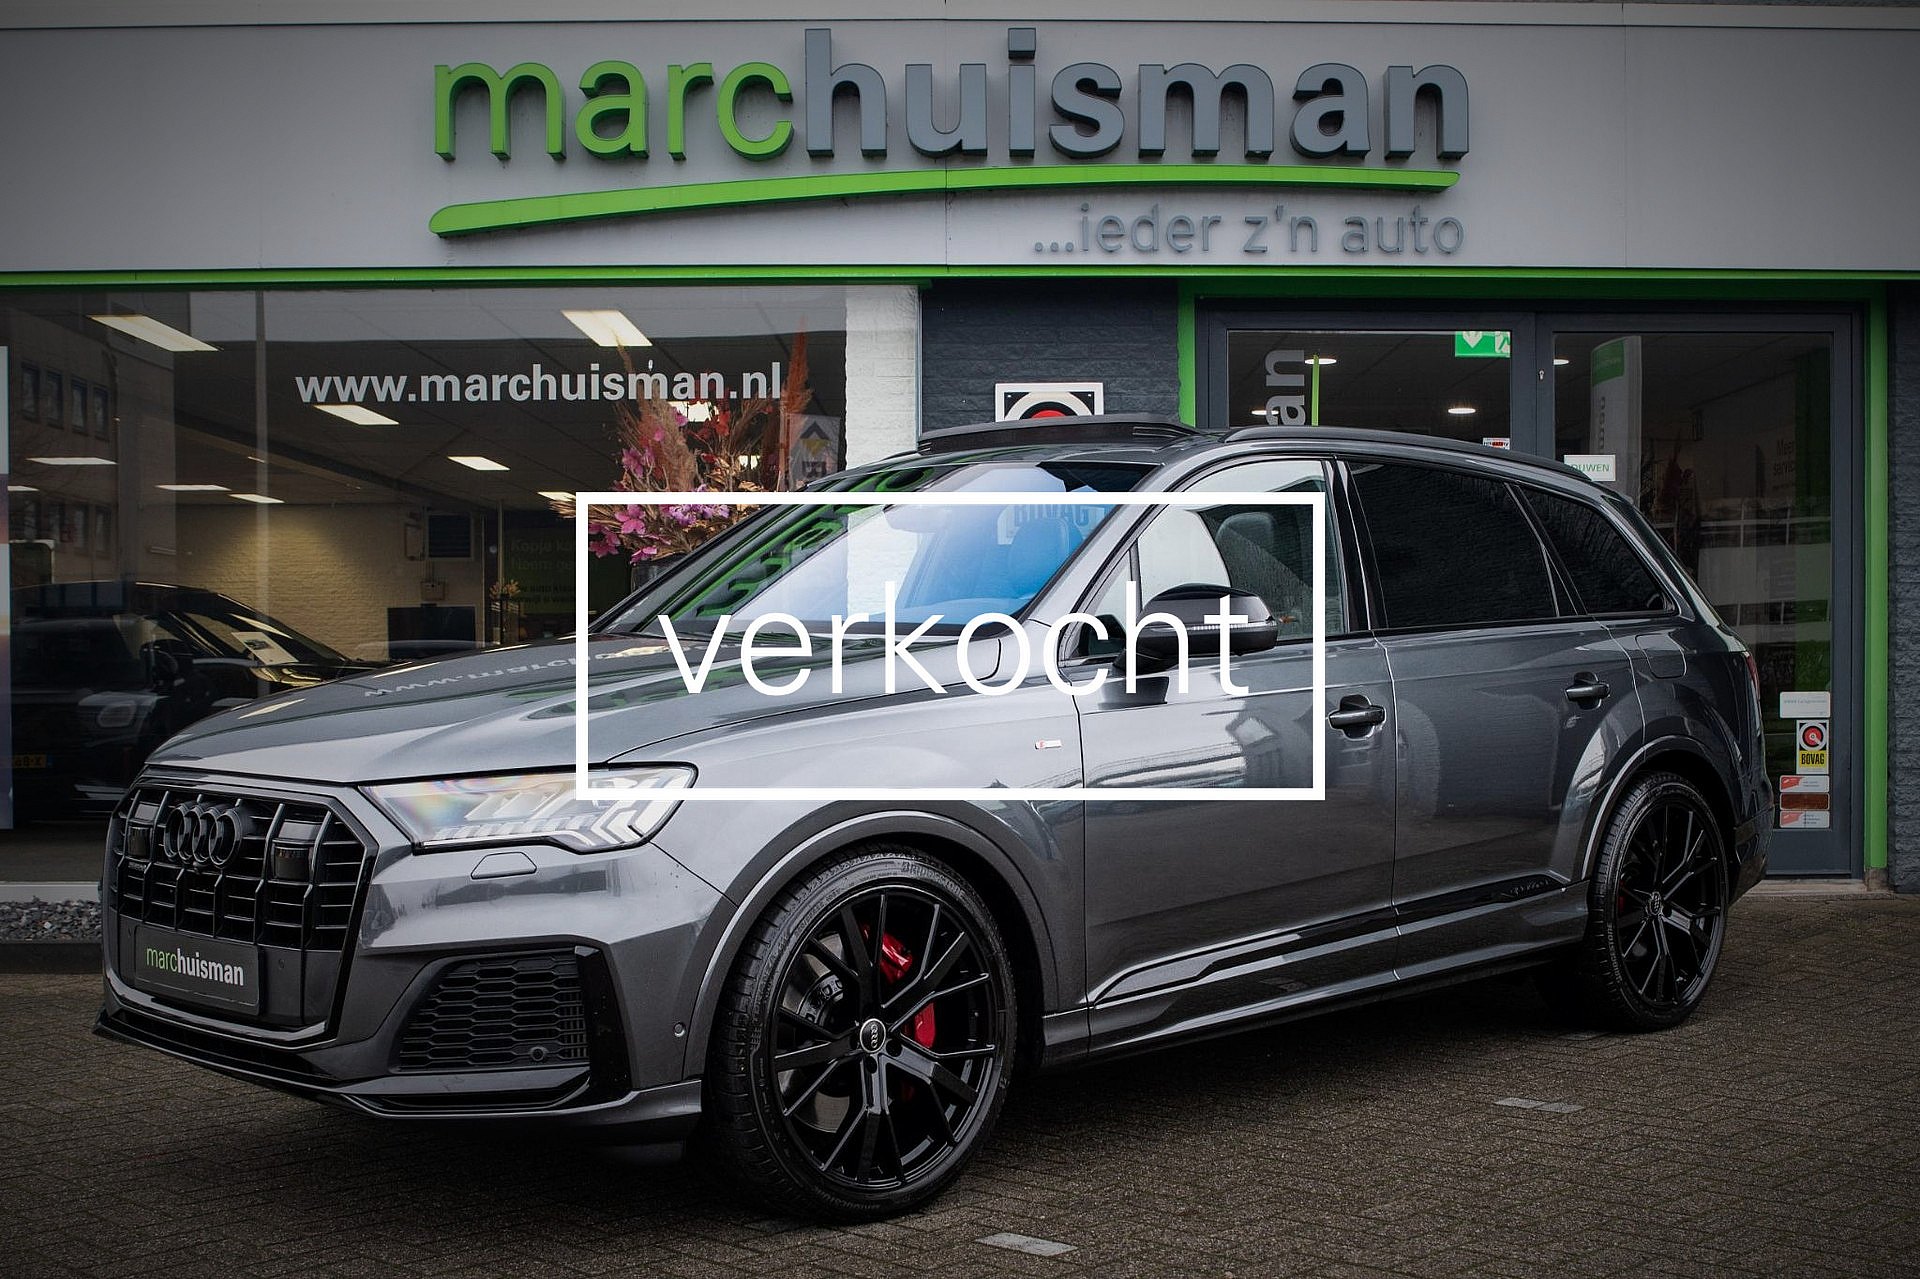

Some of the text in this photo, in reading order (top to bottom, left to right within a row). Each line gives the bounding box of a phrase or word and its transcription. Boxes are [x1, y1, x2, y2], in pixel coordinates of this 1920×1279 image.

[434, 27, 1469, 161] marchuisman
[1244, 204, 1318, 253] z'n
[1342, 204, 1465, 255] auto
[295, 361, 782, 403] www.marchuisman.nl
[1801, 753, 1825, 765] BOVAG
[146, 946, 244, 987] marchuisman
